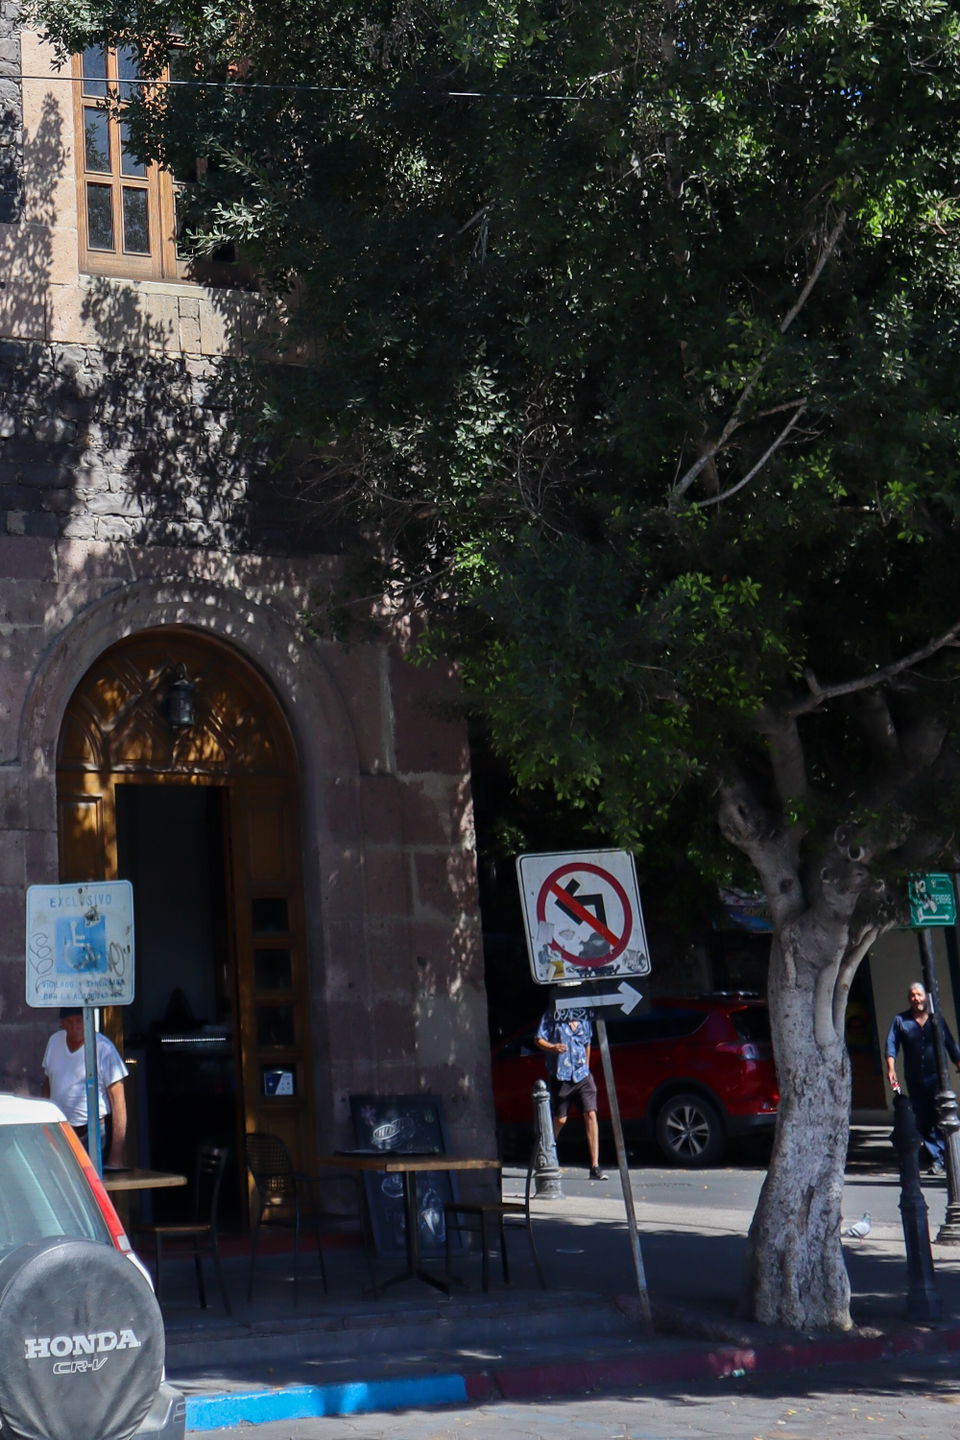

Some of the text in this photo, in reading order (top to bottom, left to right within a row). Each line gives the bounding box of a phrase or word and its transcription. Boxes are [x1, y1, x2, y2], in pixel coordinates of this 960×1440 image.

[49, 893, 112, 908] EXCLUSIVO
[24, 1329, 142, 1359] HONDA
[52, 1357, 109, 1375] CR-V
